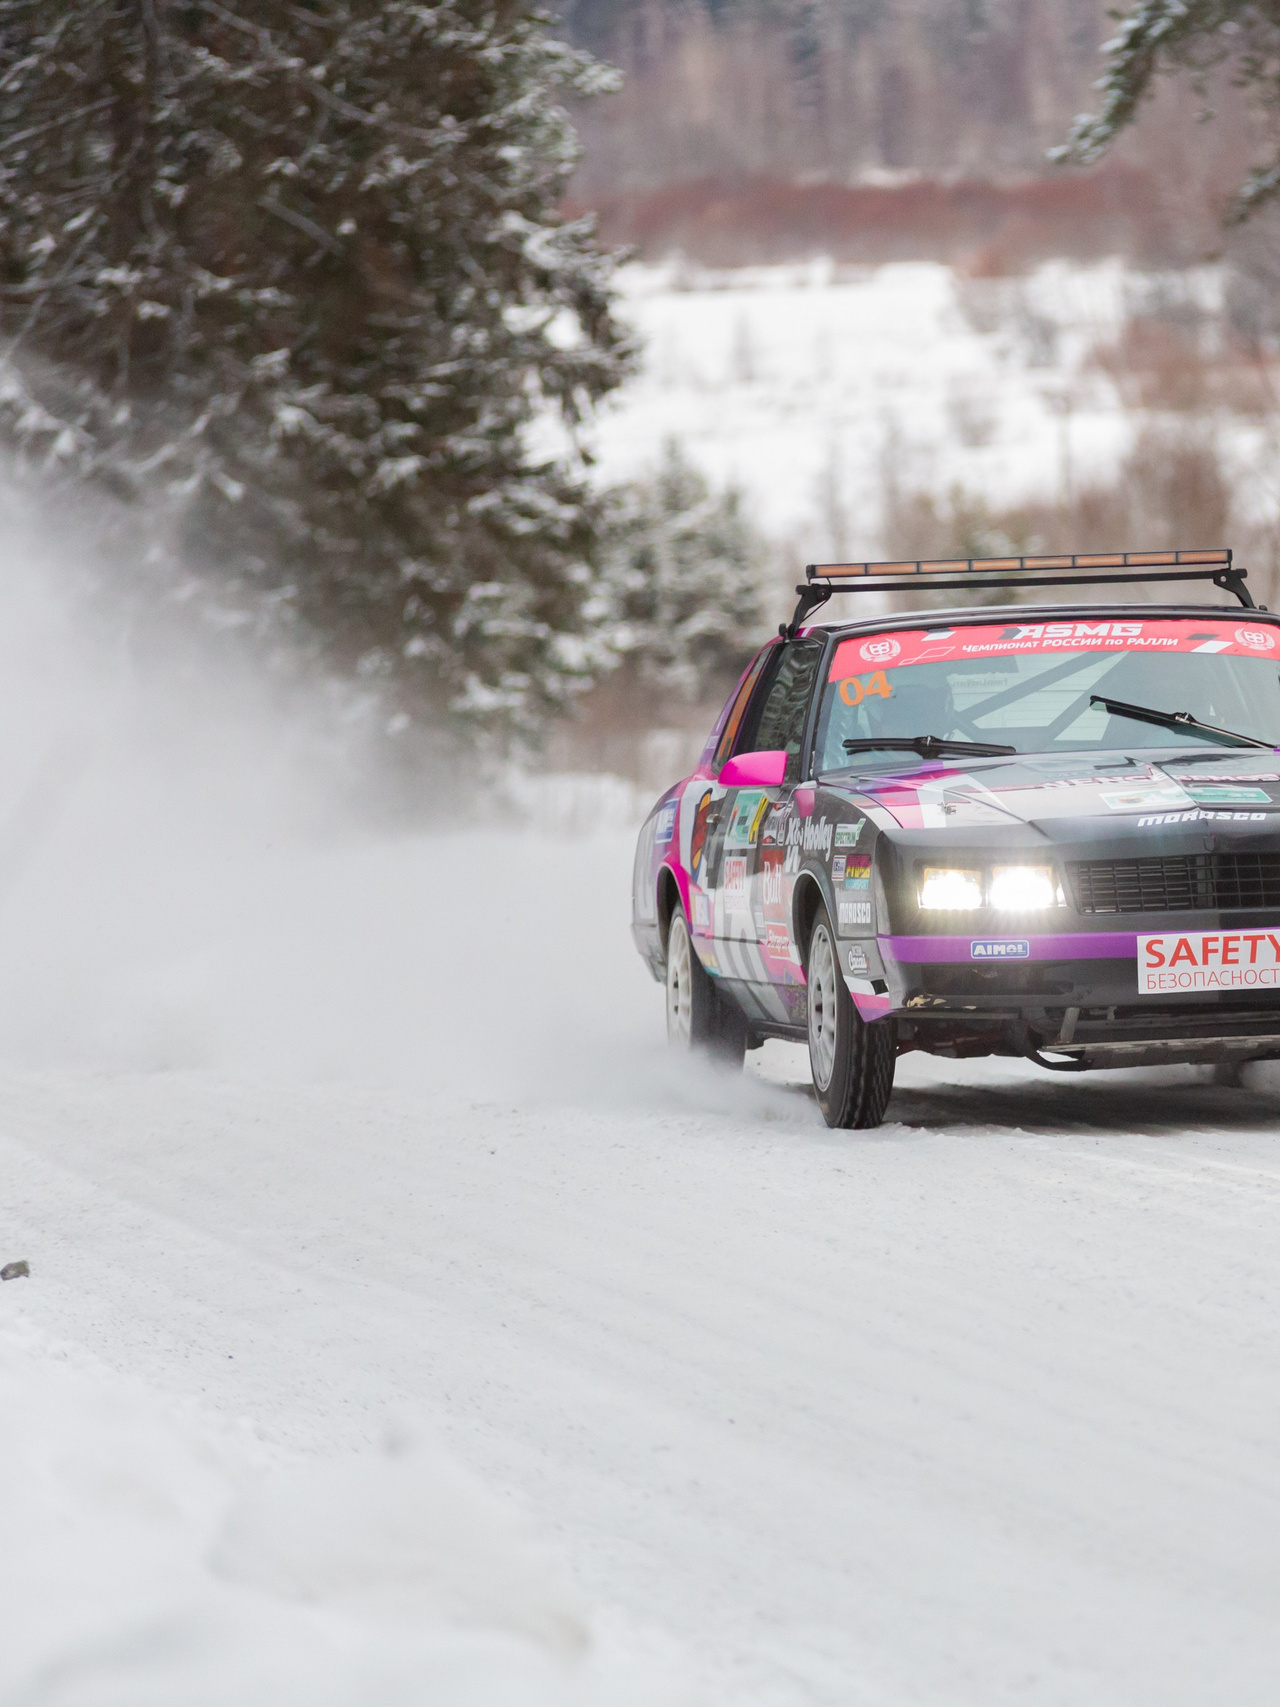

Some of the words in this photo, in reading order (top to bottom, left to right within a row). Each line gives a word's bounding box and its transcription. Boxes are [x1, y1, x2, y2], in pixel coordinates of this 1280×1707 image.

[1042, 638, 1103, 648] РОССИИ
[1126, 637, 1179, 646] РАЛЛИ
[839, 669, 894, 708] 04
[973, 944, 1026, 956] AIMOL
